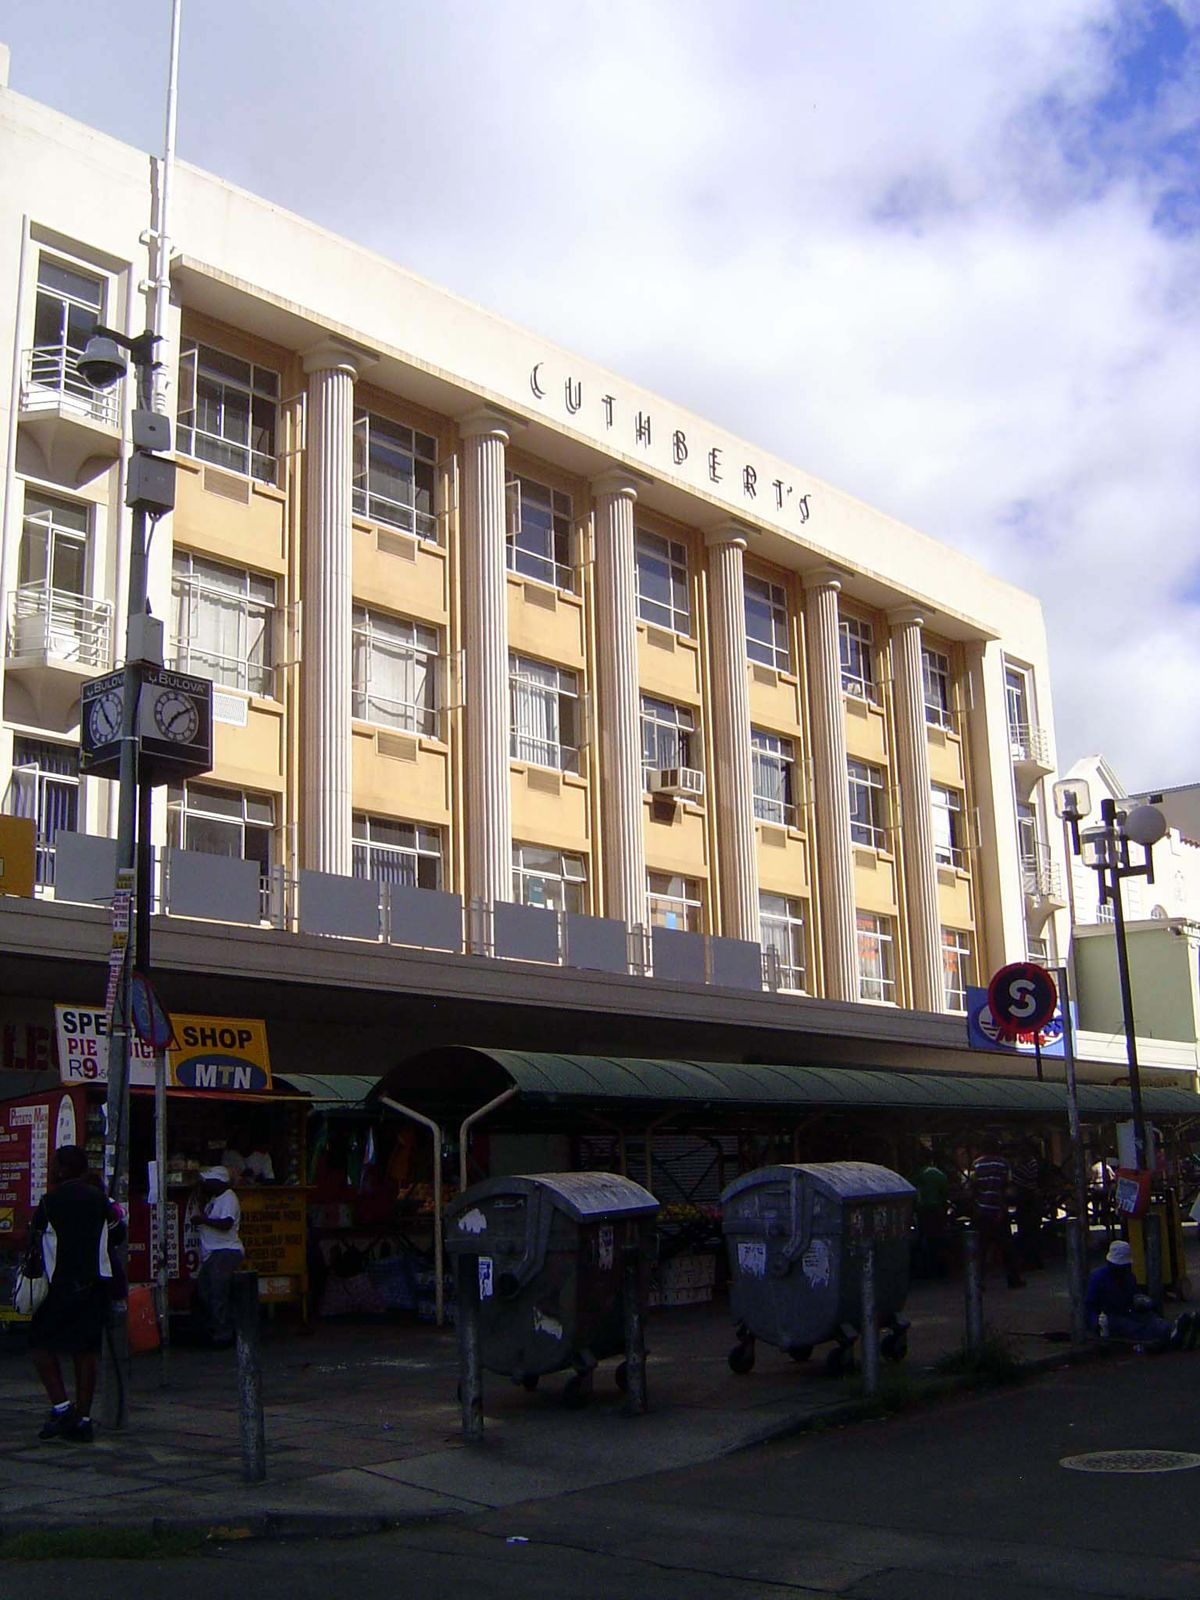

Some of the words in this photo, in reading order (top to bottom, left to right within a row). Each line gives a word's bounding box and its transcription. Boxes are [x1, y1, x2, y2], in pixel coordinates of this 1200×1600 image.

[530, 362, 811, 524] CUTHBERT'S
[94, 675, 124, 693] BULOV
[159, 673, 205, 693] BULOVA
[1008, 979, 1036, 1018] S
[67, 1038, 98, 1057] PIE
[184, 1026, 253, 1049] SHOP
[194, 1064, 252, 1089] MTN
